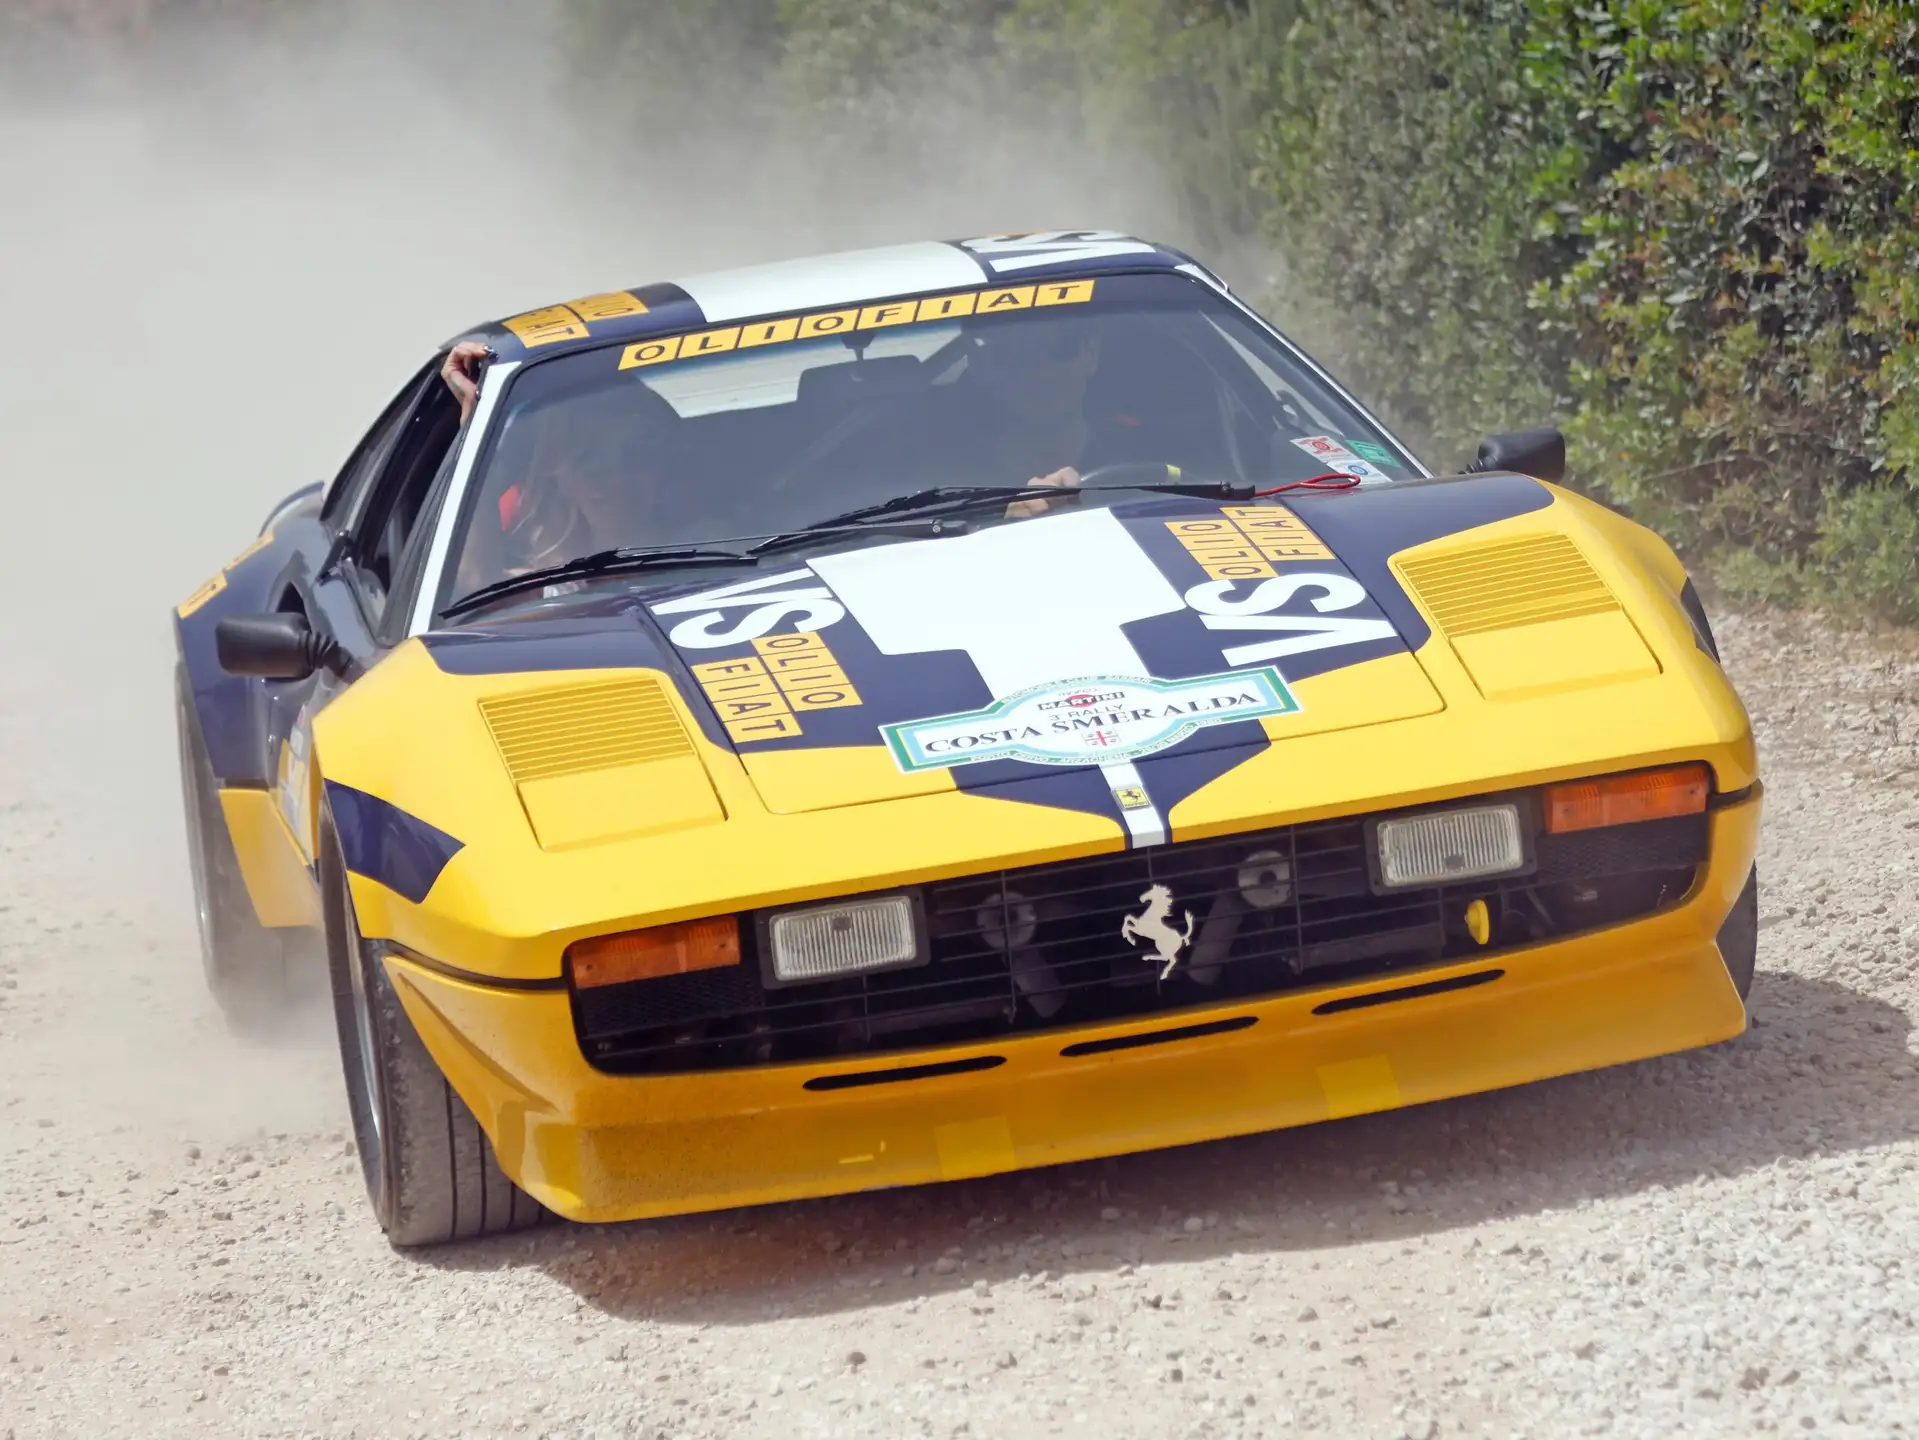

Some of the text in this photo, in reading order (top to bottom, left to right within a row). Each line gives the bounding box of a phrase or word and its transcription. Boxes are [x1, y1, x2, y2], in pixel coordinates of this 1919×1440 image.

[1180, 522, 1262, 577] OLIO
[1236, 509, 1320, 558] FIAT
[649, 567, 846, 649] VS
[1184, 572, 1399, 668] VS
[706, 663, 786, 732] FIAT
[766, 637, 846, 704] OLIO
[925, 693, 1261, 753] COSTA SMERALDA
[1038, 691, 1126, 711] MARTINI
[1068, 704, 1124, 718] RALLY
